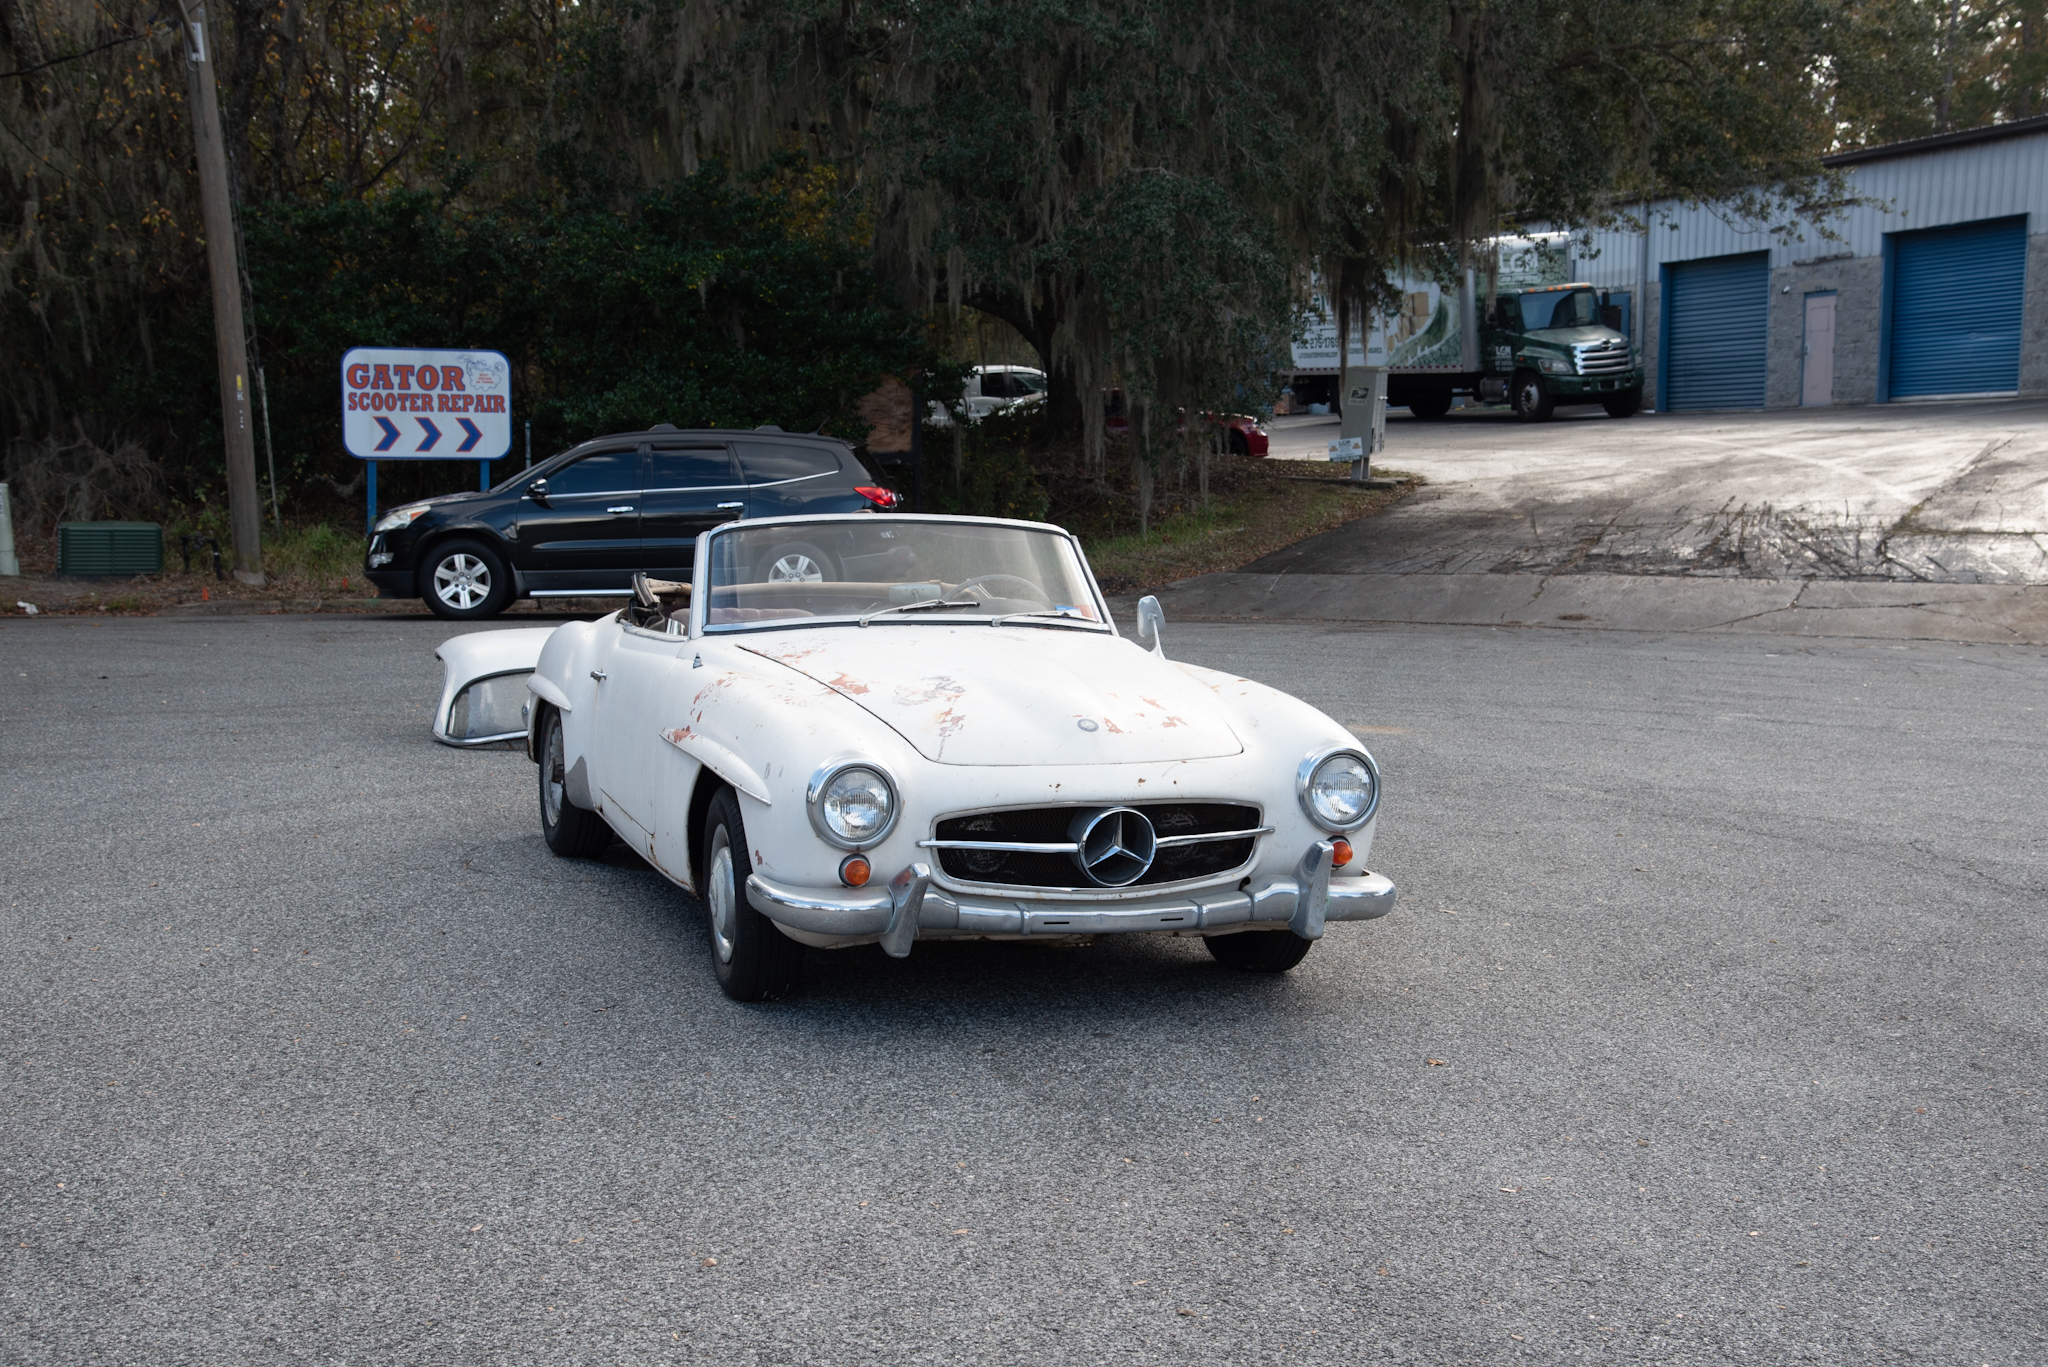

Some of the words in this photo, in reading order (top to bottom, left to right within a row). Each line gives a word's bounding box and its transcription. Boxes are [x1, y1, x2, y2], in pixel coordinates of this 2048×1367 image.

[1499, 253, 1539, 274] LGM
[1495, 345, 1511, 356] LGM
[346, 363, 466, 391] GATOR
[348, 392, 434, 412] SCOOTER
[437, 393, 506, 413] REPAIR
